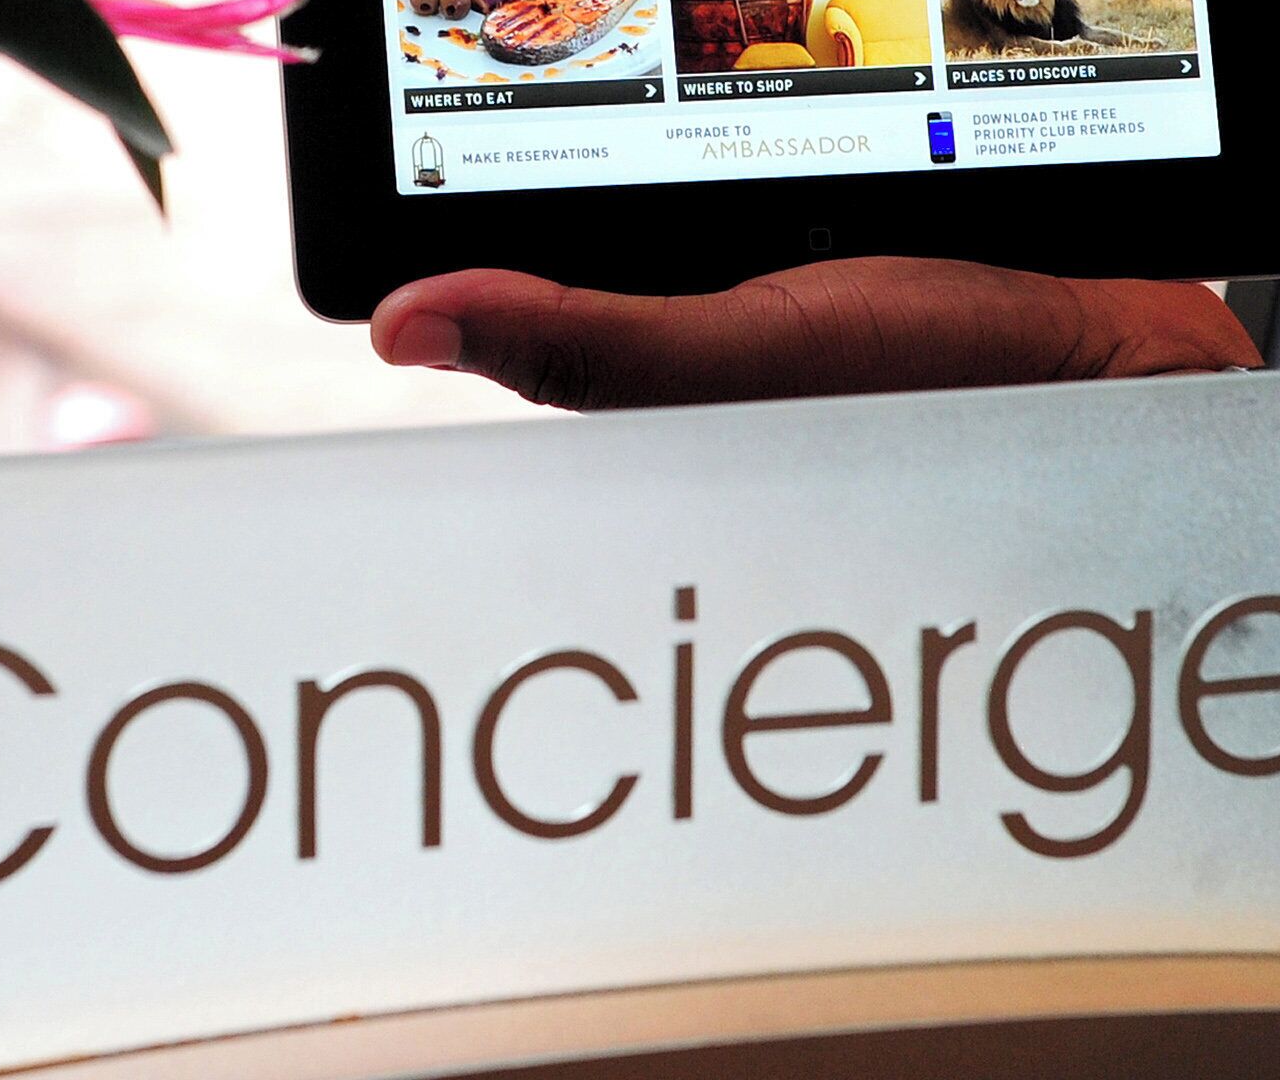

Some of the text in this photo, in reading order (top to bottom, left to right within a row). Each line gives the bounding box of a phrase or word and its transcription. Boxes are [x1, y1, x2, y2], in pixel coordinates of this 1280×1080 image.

[952, 65, 1096, 83] PLACES TO DISCOVER
[683, 79, 792, 95] WHERE TO SHOP
[410, 91, 513, 107] WHERE TO EAT
[973, 108, 1116, 125] DOWNLOAD THE FREE
[666, 125, 750, 139] UPGRADE TO
[974, 122, 1144, 140] PRIORITY CLUB REWARDS
[702, 135, 871, 159] AMBASSADOR
[1030, 141, 1056, 152] APP
[462, 147, 608, 164] MAKE RESERVATIONS
